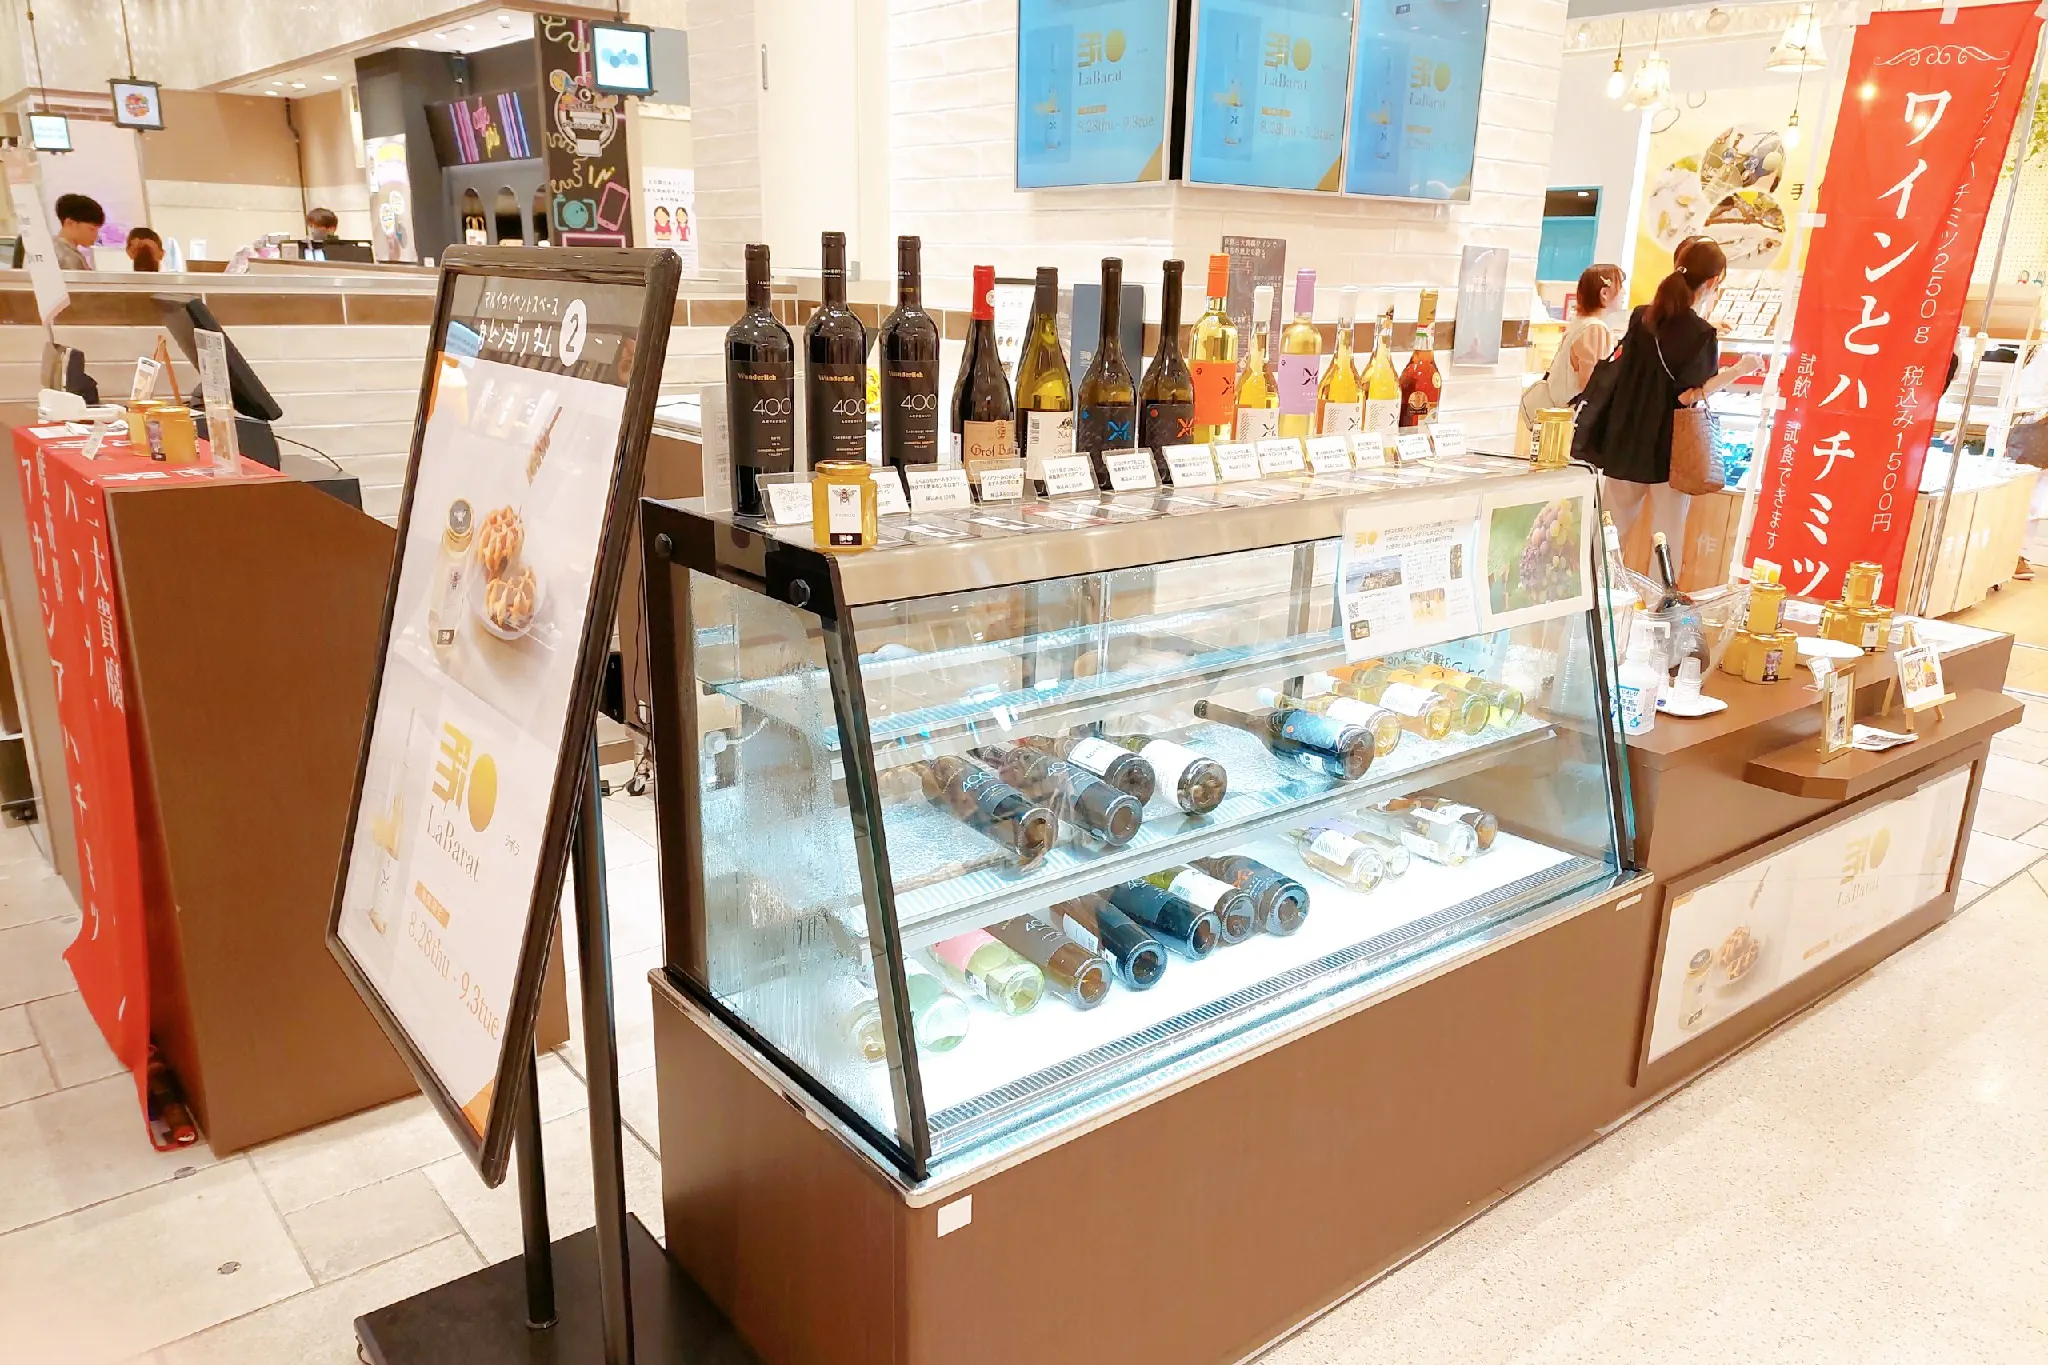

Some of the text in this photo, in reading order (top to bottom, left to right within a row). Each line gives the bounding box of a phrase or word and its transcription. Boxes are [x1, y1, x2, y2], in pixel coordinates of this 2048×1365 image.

[1078, 69, 1124, 86] LaBarat
[1263, 72, 1308, 90] LaBarat
[484, 291, 559, 316] マルイのイベントスペース
[1791, 89, 1953, 598] ワインとハチミツ
[737, 371, 777, 382] Wunderlich
[817, 373, 856, 383] Wunderlich
[752, 397, 792, 417] 400
[831, 398, 867, 417] 400
[900, 393, 937, 411] 400
[1767, 352, 1818, 550] 試飲・試食できます
[1871, 365, 1925, 533] 税込み1500円
[426, 803, 480, 883] LaBarat
[408, 910, 450, 978] 8.28thu
[458, 970, 500, 1041] 9.3tue
